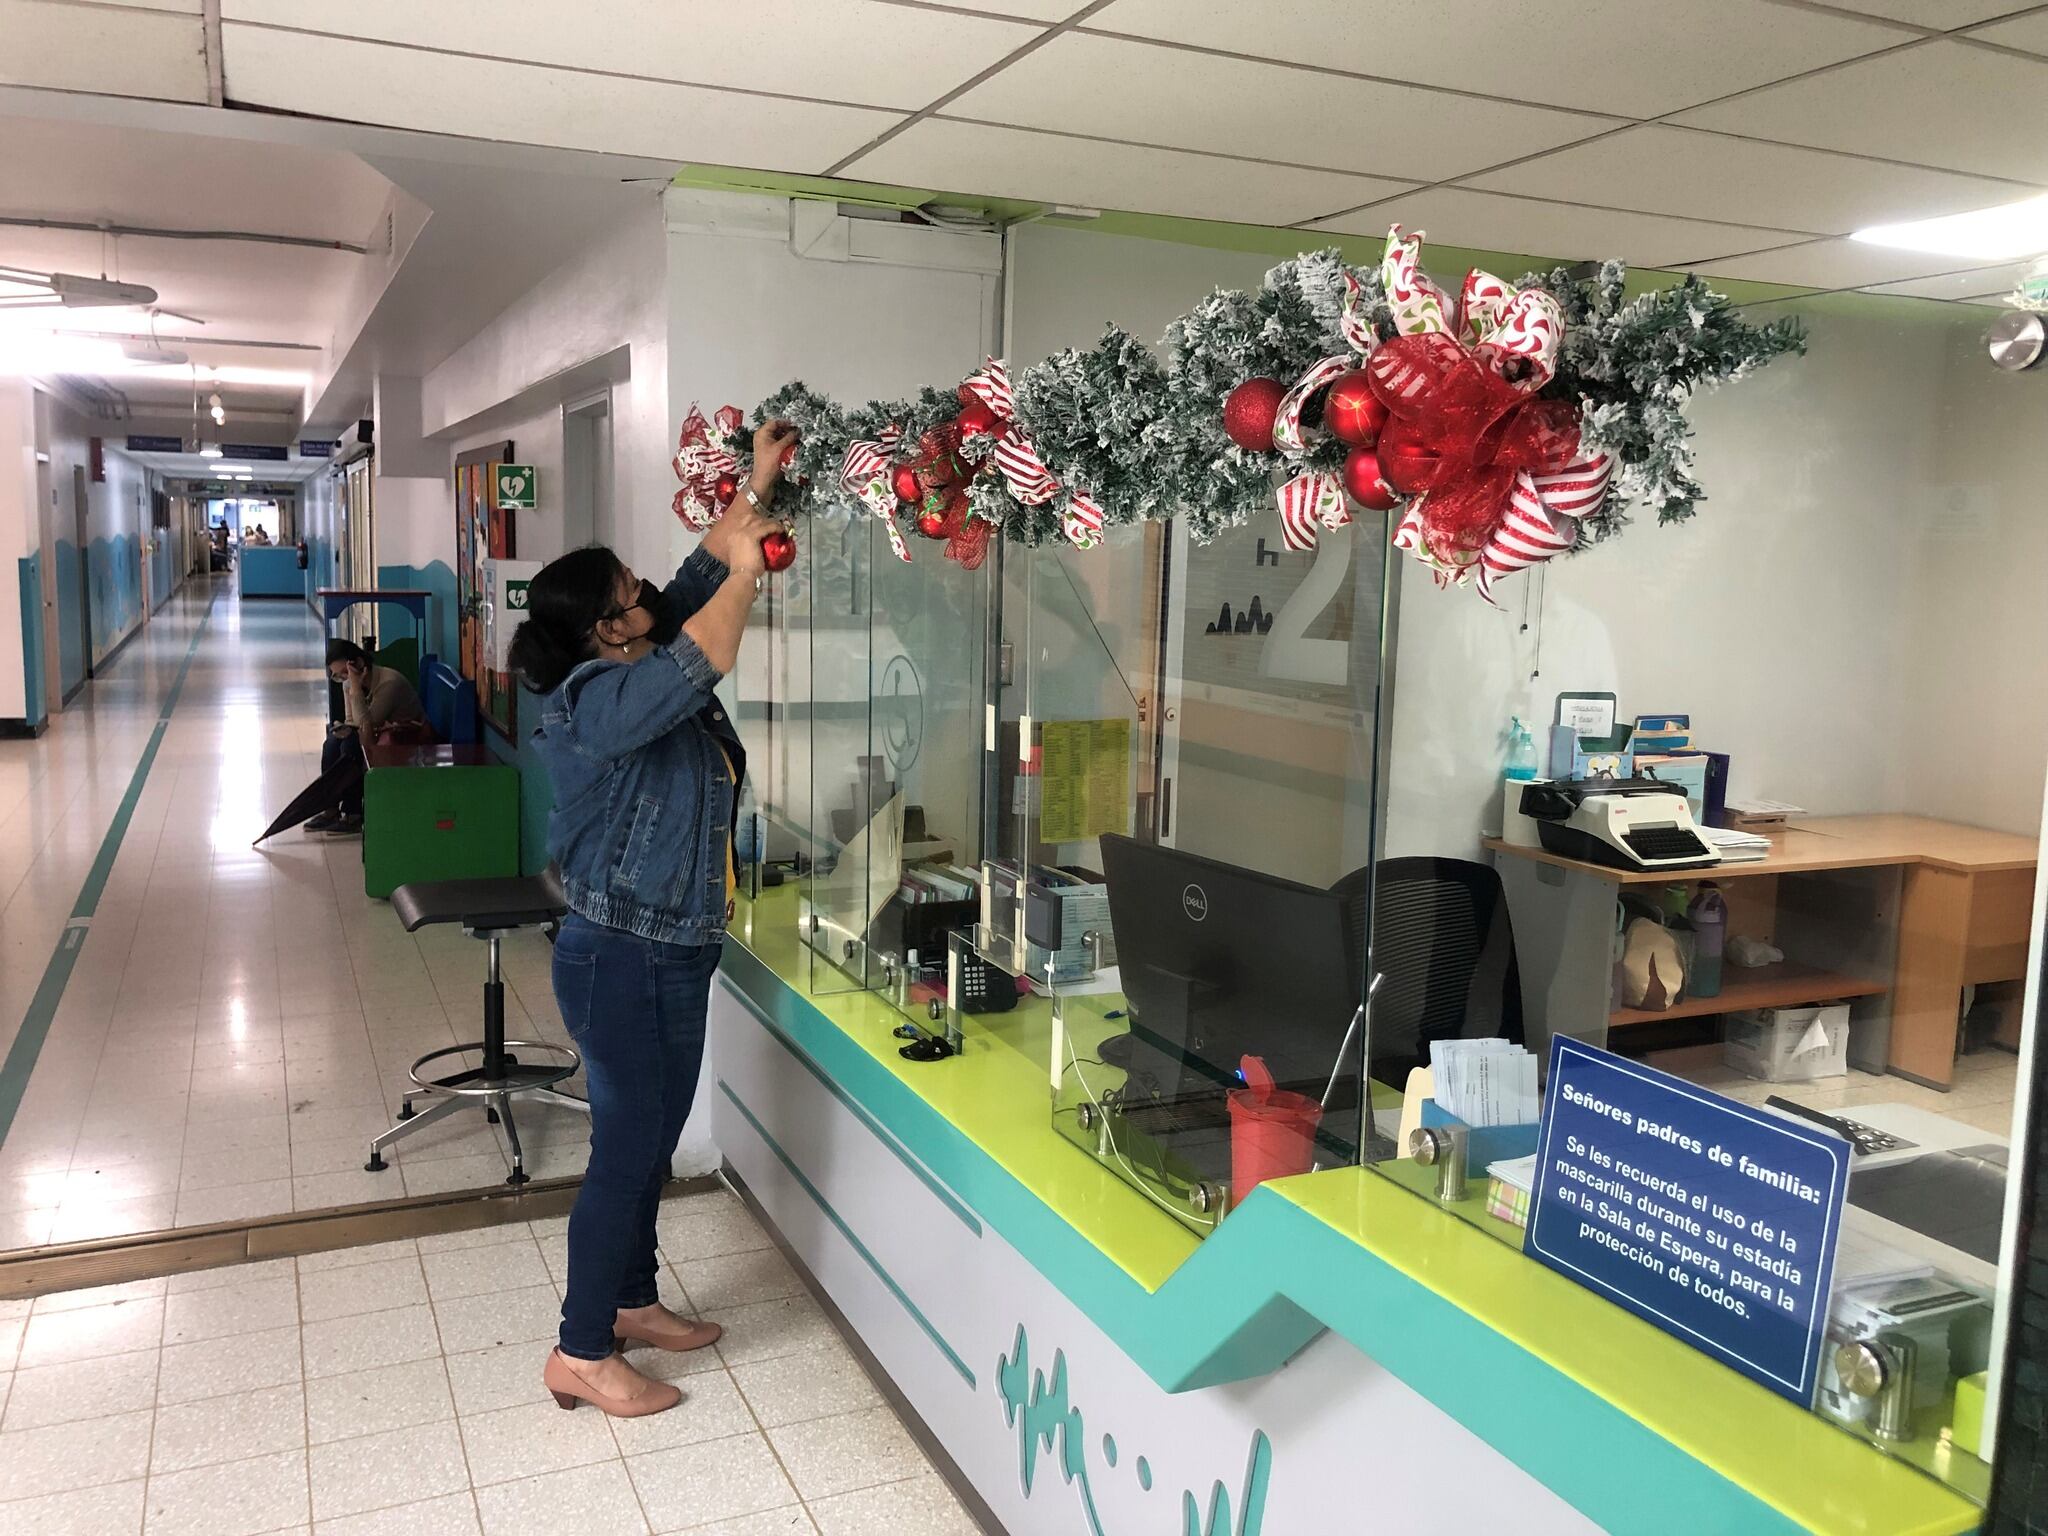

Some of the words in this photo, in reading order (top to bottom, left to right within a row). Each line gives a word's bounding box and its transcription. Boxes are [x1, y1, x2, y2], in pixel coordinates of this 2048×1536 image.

[1186, 895, 1205, 910] DELL
[1562, 1083, 1632, 1126] Señores
[1636, 1117, 1702, 1155] padres
[1707, 1144, 1733, 1168] de
[1738, 1155, 1821, 1205] familia:
[1566, 1135, 1586, 1157] Se
[1589, 1144, 1611, 1169] les
[1615, 1160, 1687, 1204] recuerda
[1691, 1194, 1708, 1213] el
[1712, 1203, 1746, 1230] uso
[1750, 1219, 1775, 1243] de
[1779, 1229, 1797, 1254] la
[1555, 1159, 1633, 1206] mascarilla
[1636, 1195, 1702, 1237] durante
[1705, 1229, 1728, 1251] su
[1732, 1242, 1802, 1286] estadía
[1558, 1186, 1577, 1205] en
[1580, 1192, 1594, 1213] la
[1597, 1201, 1632, 1232] Sala
[1635, 1221, 1656, 1243] de
[1659, 1230, 1725, 1280] Espera,
[1729, 1269, 1772, 1301] para
[1776, 1287, 1795, 1313] la
[1579, 1222, 1664, 1275] protección
[1668, 1265, 1690, 1287] de
[1694, 1276, 1751, 1320] todos.
